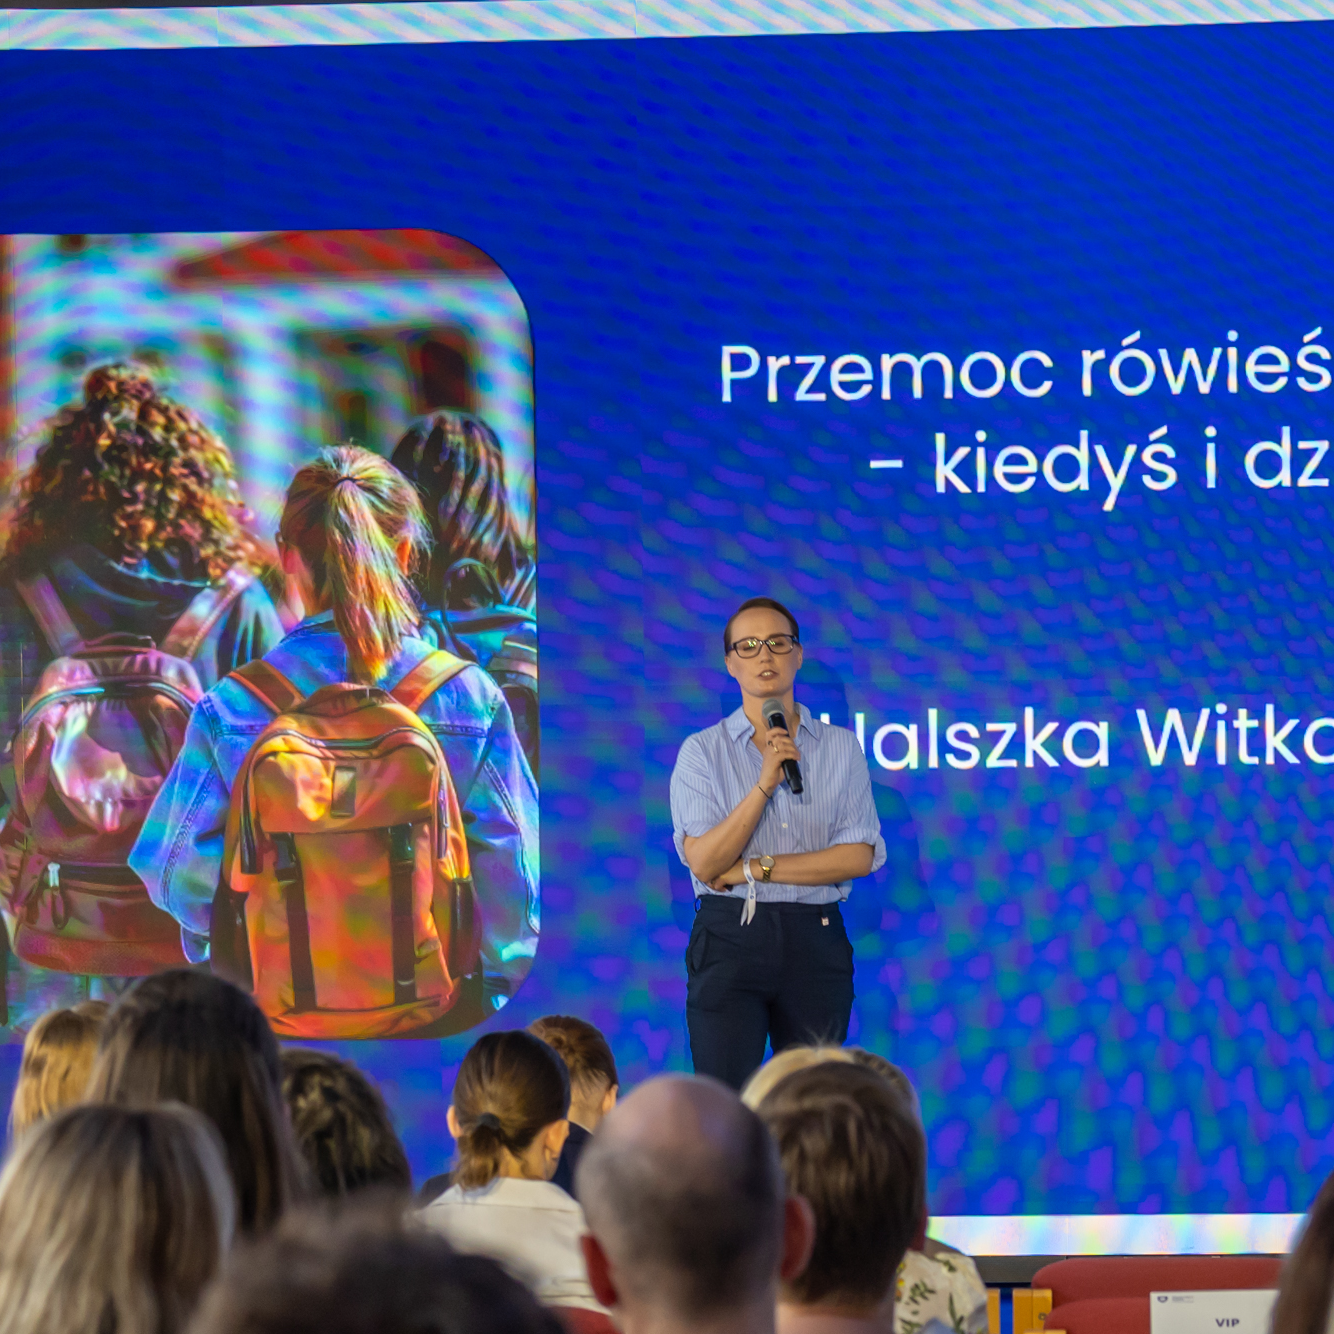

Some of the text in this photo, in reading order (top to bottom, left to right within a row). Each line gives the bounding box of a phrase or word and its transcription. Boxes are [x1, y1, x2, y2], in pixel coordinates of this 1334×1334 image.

[720, 343, 1054, 403] Przemoc
[934, 422, 1178, 512] kiedyś
[1205, 425, 1218, 488] i
[1215, 1318, 1240, 1328] VIP
